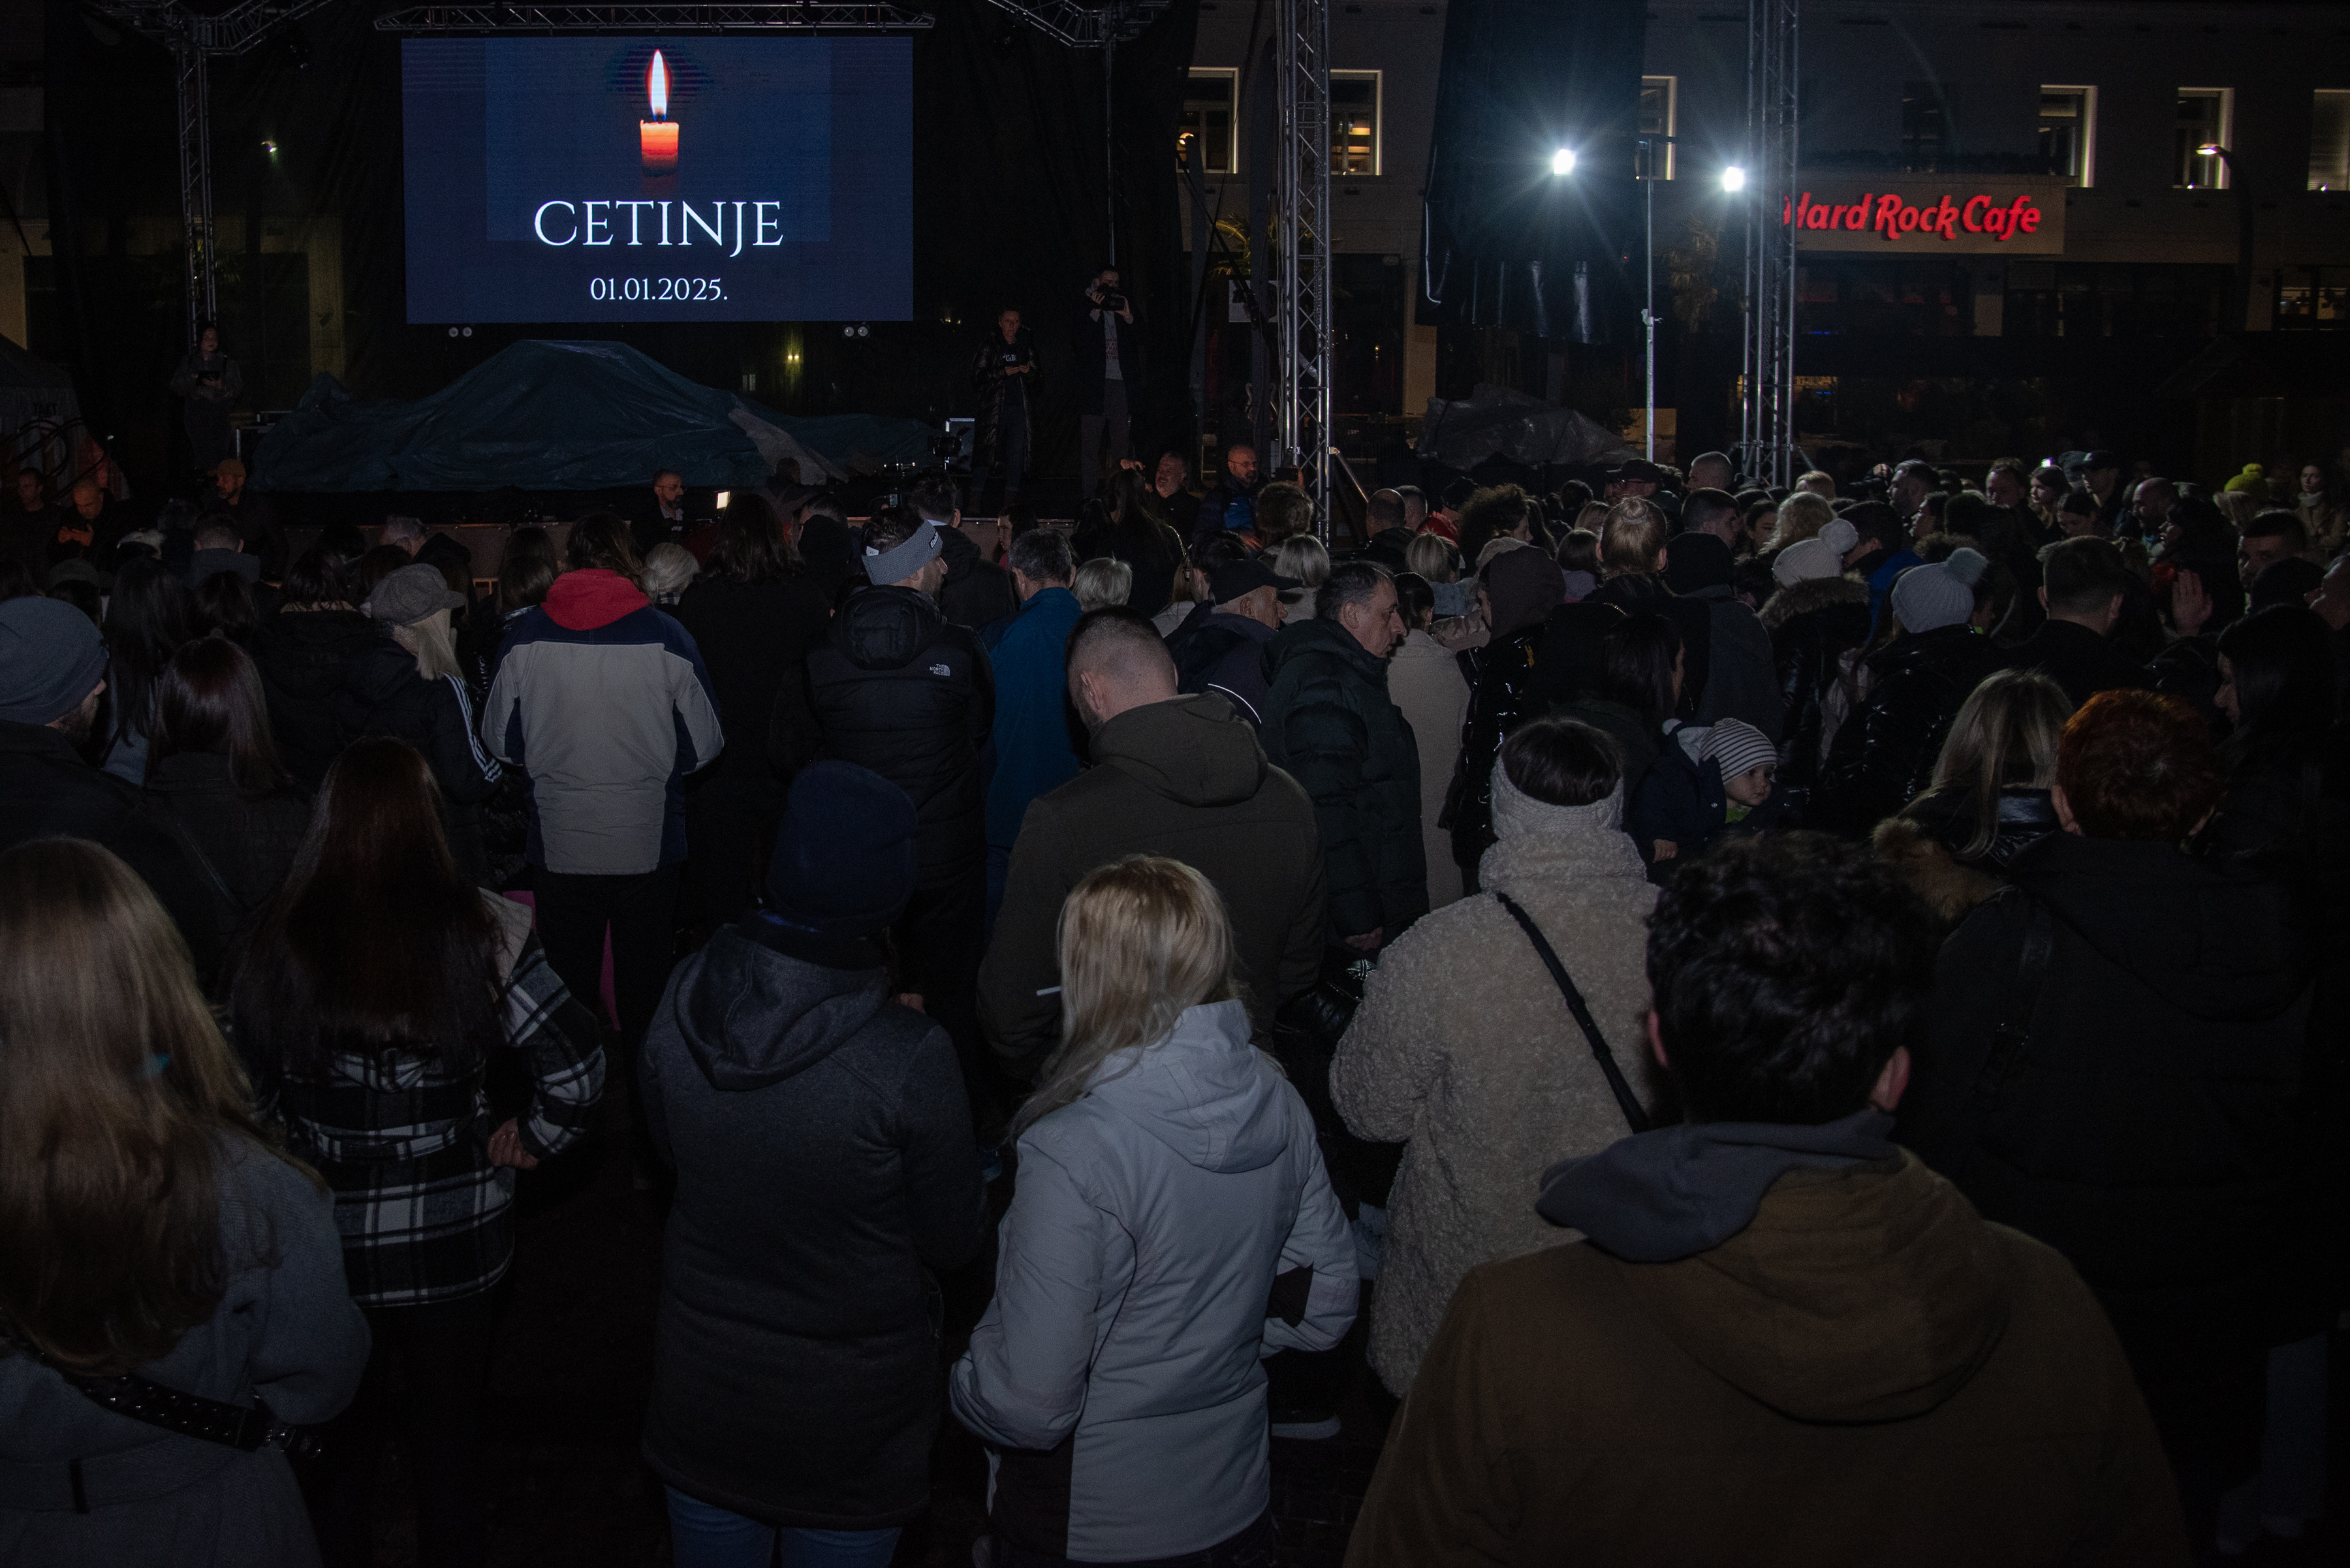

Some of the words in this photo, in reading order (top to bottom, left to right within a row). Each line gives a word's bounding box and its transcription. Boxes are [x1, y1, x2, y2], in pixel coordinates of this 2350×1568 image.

[534, 200, 784, 257] CETINJE
[1875, 194, 1958, 239] Rock
[1963, 195, 2041, 240] Cafe
[590, 277, 728, 301] 01.01.2025.
